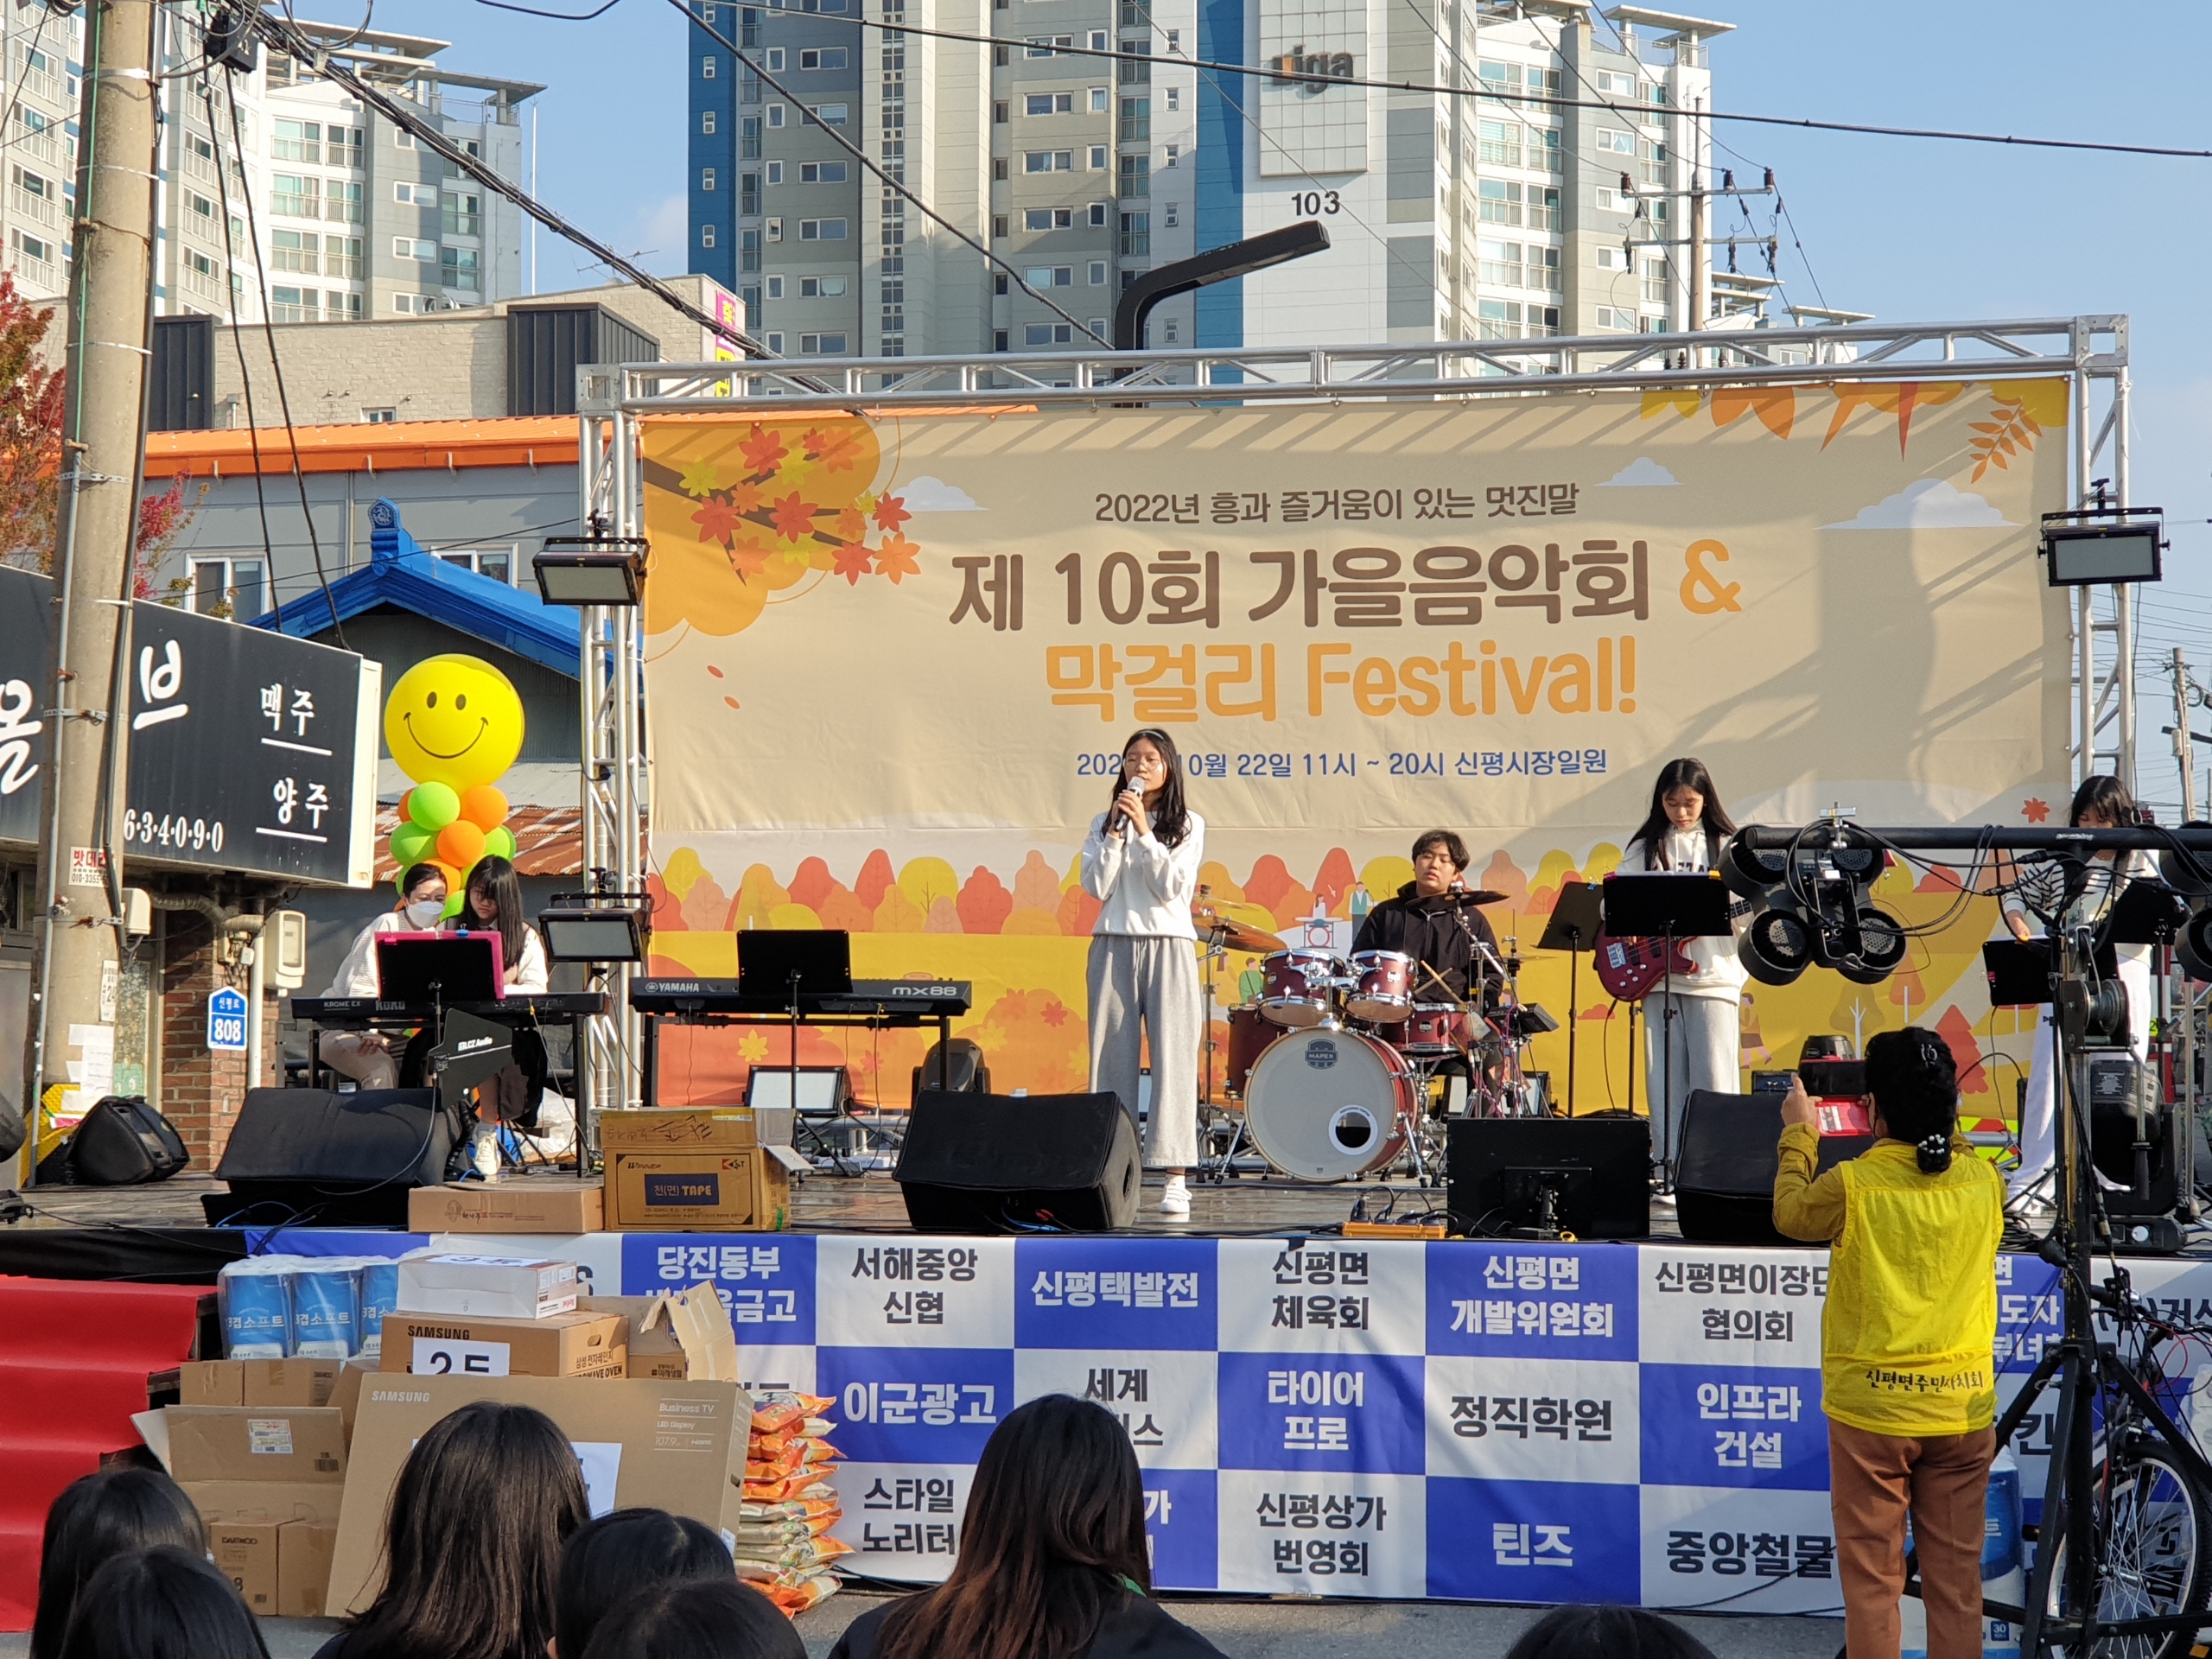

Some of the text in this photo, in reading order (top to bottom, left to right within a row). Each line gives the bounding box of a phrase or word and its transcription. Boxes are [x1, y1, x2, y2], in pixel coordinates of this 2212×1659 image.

[1291, 191, 1340, 216] 103
[1096, 483, 1580, 524] 2022년 흥과 즐거움이 있는 멋진말
[949, 538, 1743, 632] 제 10회 가을음악회 &
[1046, 635, 1637, 722] 막걸리 Festival!
[1236, 753, 1293, 778] 22일
[1303, 753, 1357, 777] 11시
[1389, 752, 1445, 777] 20시
[1454, 749, 1608, 777] 신평시장일원
[219, 997, 240, 1010] 신평로
[658, 982, 700, 993] YAMAHA
[214, 1018, 242, 1042] 808
[682, 1185, 712, 1197] TAPE
[658, 1245, 781, 1281] 당진동부
[851, 1247, 978, 1281] 서해중앙
[1272, 1251, 1369, 1286] 신평면
[1483, 1255, 1580, 1291] 신평면
[1031, 1271, 1199, 1307] 신평택발전
[883, 1291, 944, 1325] 신협
[1272, 1295, 1370, 1331] 체육회
[1450, 1300, 1614, 1338] 개발위원회
[1701, 1308, 1794, 1342] 협의회
[408, 1325, 470, 1340] SAMSUNG
[605, 1364, 622, 1378] OVEN
[1085, 1368, 1148, 1402] 세계
[1268, 1370, 1364, 1407] 타이어
[372, 1390, 430, 1403] SAMSUNG
[659, 1402, 715, 1414] Business TV
[843, 1382, 997, 1426] 이군광고
[1696, 1382, 1802, 1422] 인프라
[1283, 1416, 1349, 1451] 프로
[1450, 1395, 1613, 1442] 정직학원
[1713, 1430, 1783, 1469] 건설
[863, 1478, 954, 1514] 스타일
[1256, 1492, 1387, 1531] 신평상가
[862, 1523, 956, 1556] 노리터
[1492, 1522, 1574, 1567] 틴즈
[1666, 1529, 1835, 1580] 중앙철물
[1274, 1540, 1369, 1577] 번영회
[1993, 1624, 2006, 1633] 30
